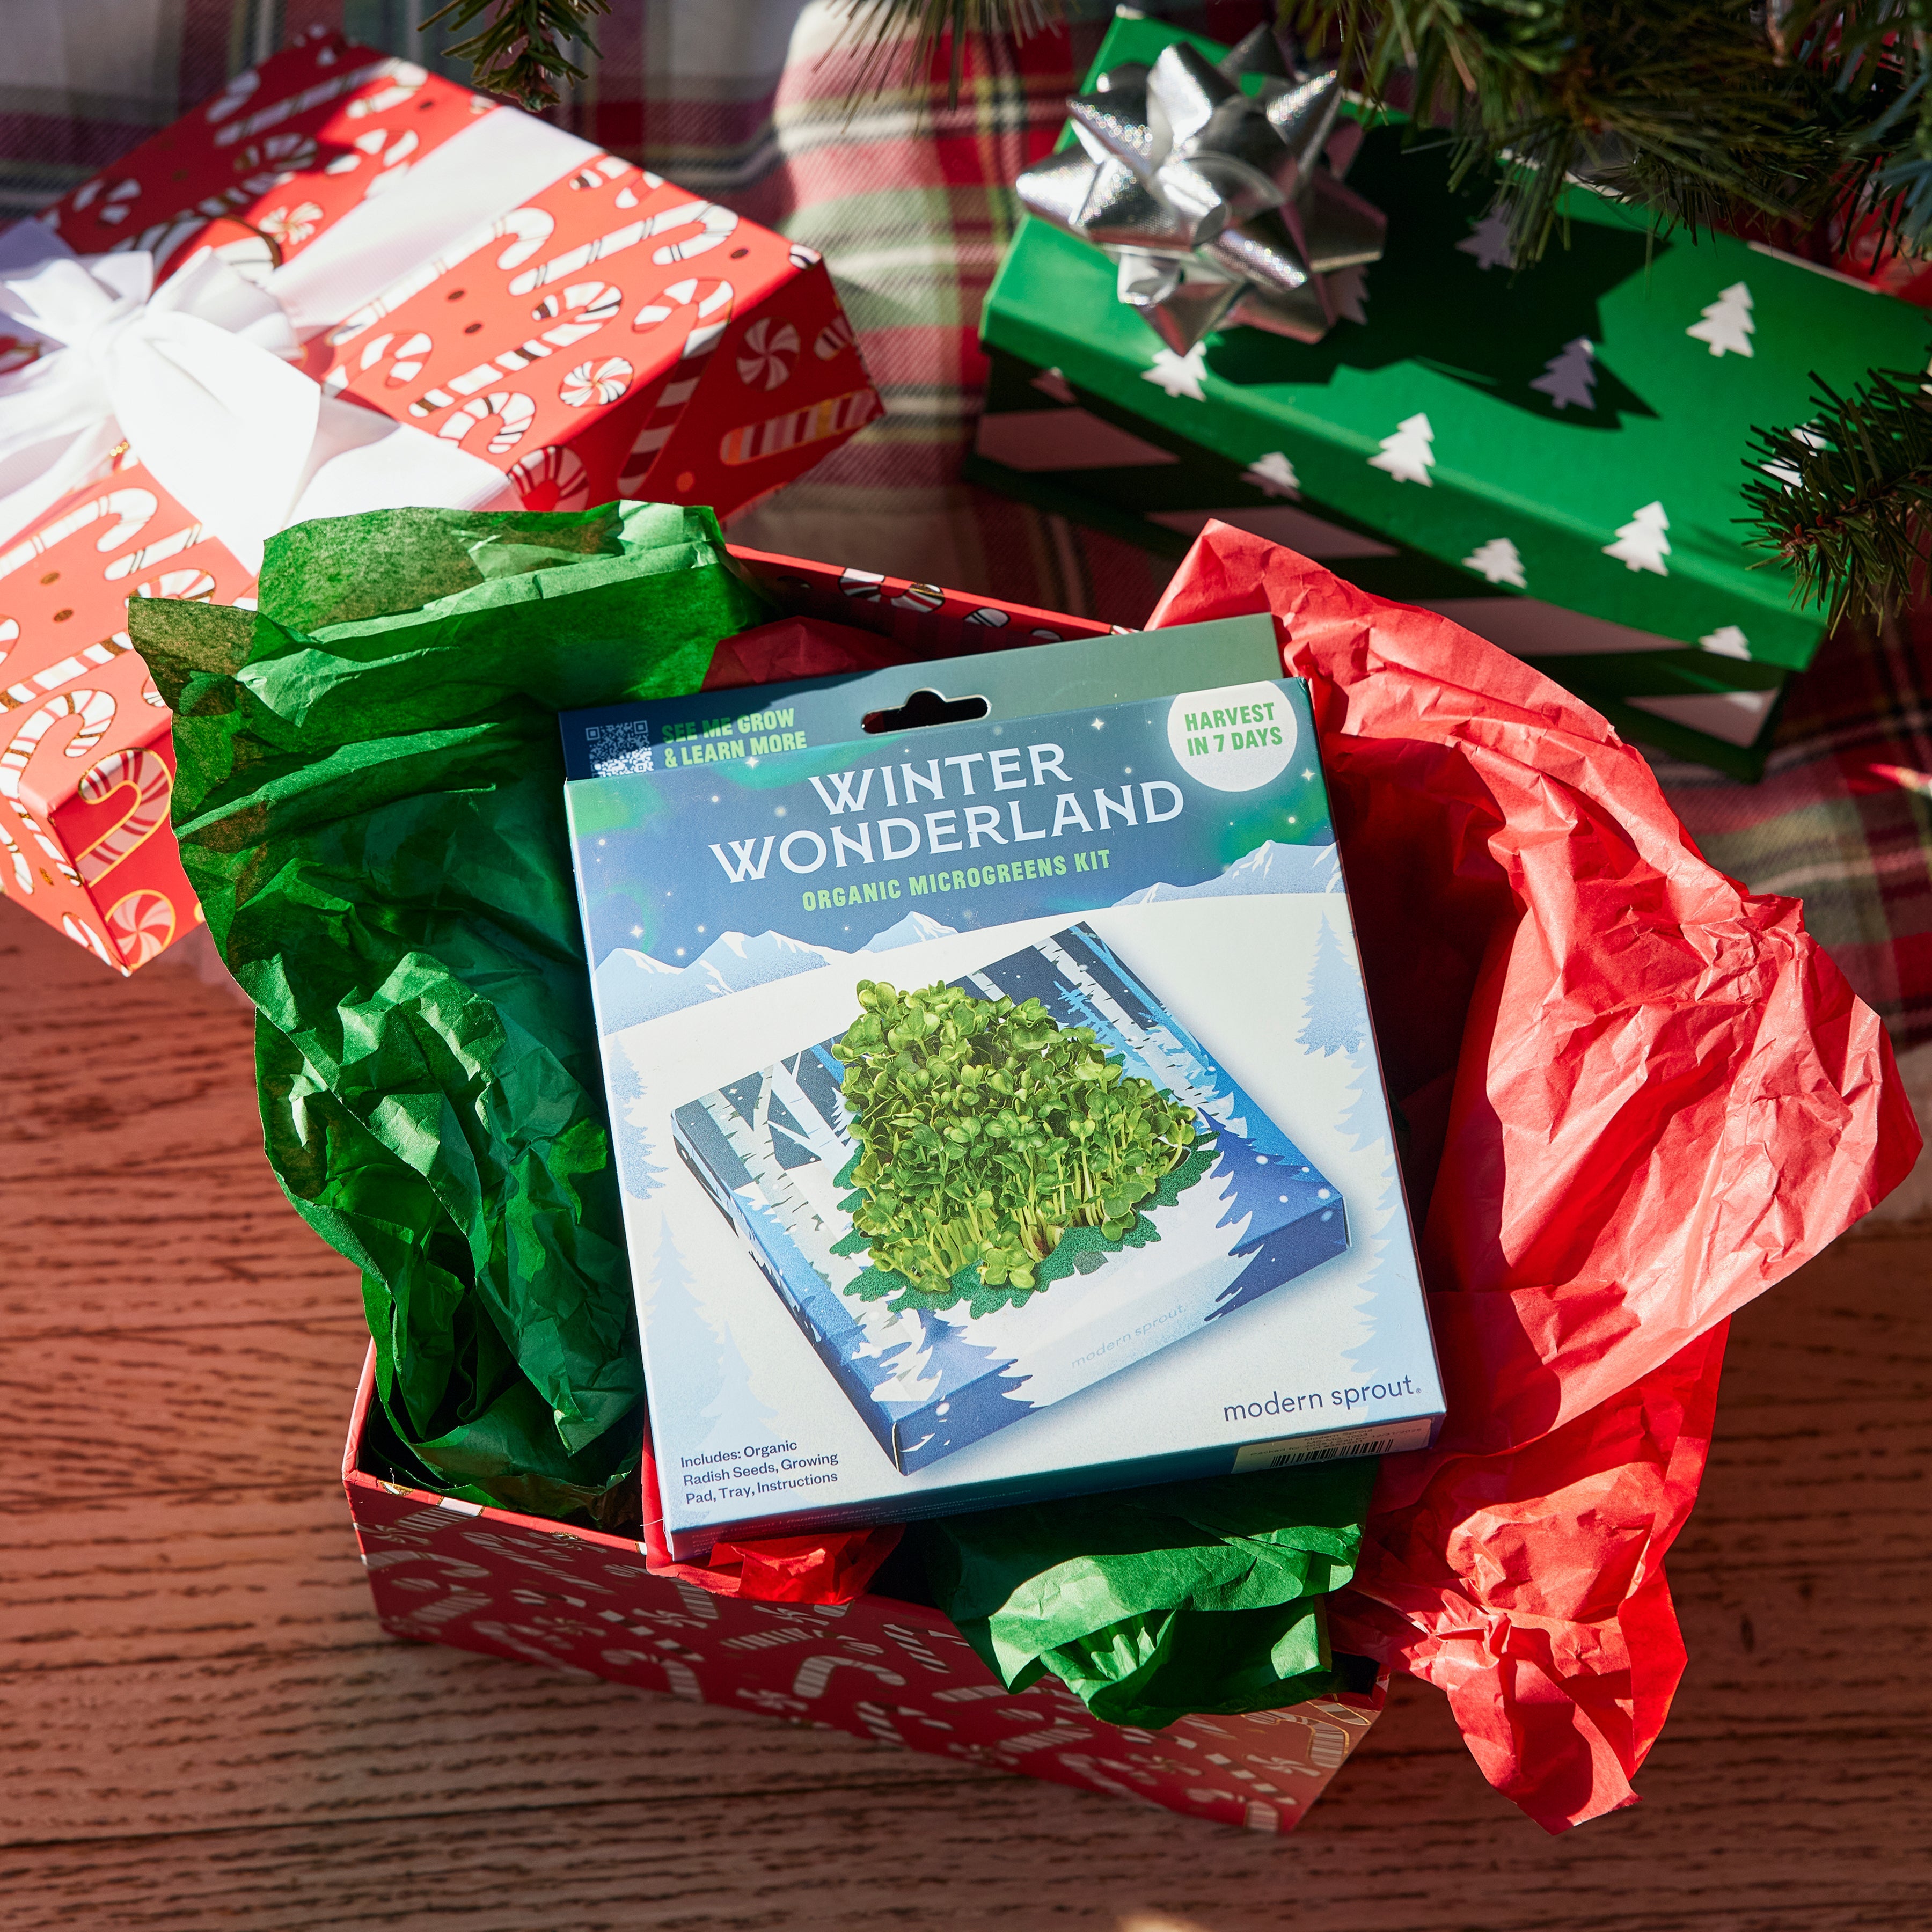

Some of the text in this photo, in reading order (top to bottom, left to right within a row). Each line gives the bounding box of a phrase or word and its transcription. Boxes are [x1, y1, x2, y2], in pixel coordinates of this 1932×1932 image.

[662, 707, 795, 744] SEE ME GROW
[1184, 702, 1275, 732] HARVEST
[664, 731, 807, 769] & LEARN MORE
[1187, 726, 1283, 757] IN 7 DAYS
[807, 742, 1073, 816] WINTER
[707, 780, 1185, 883] WONDERLAND
[801, 848, 1111, 912] ORGANIC MICROGREENS KIT
[1071, 1333, 1131, 1368] modern
[1223, 1391, 1323, 1422] modern
[680, 1440, 797, 1468] Includes: Organic
[683, 1452, 839, 1486] Radish Seeds, Growing
[685, 1473, 838, 1505] Pad, Tray, Instructions
